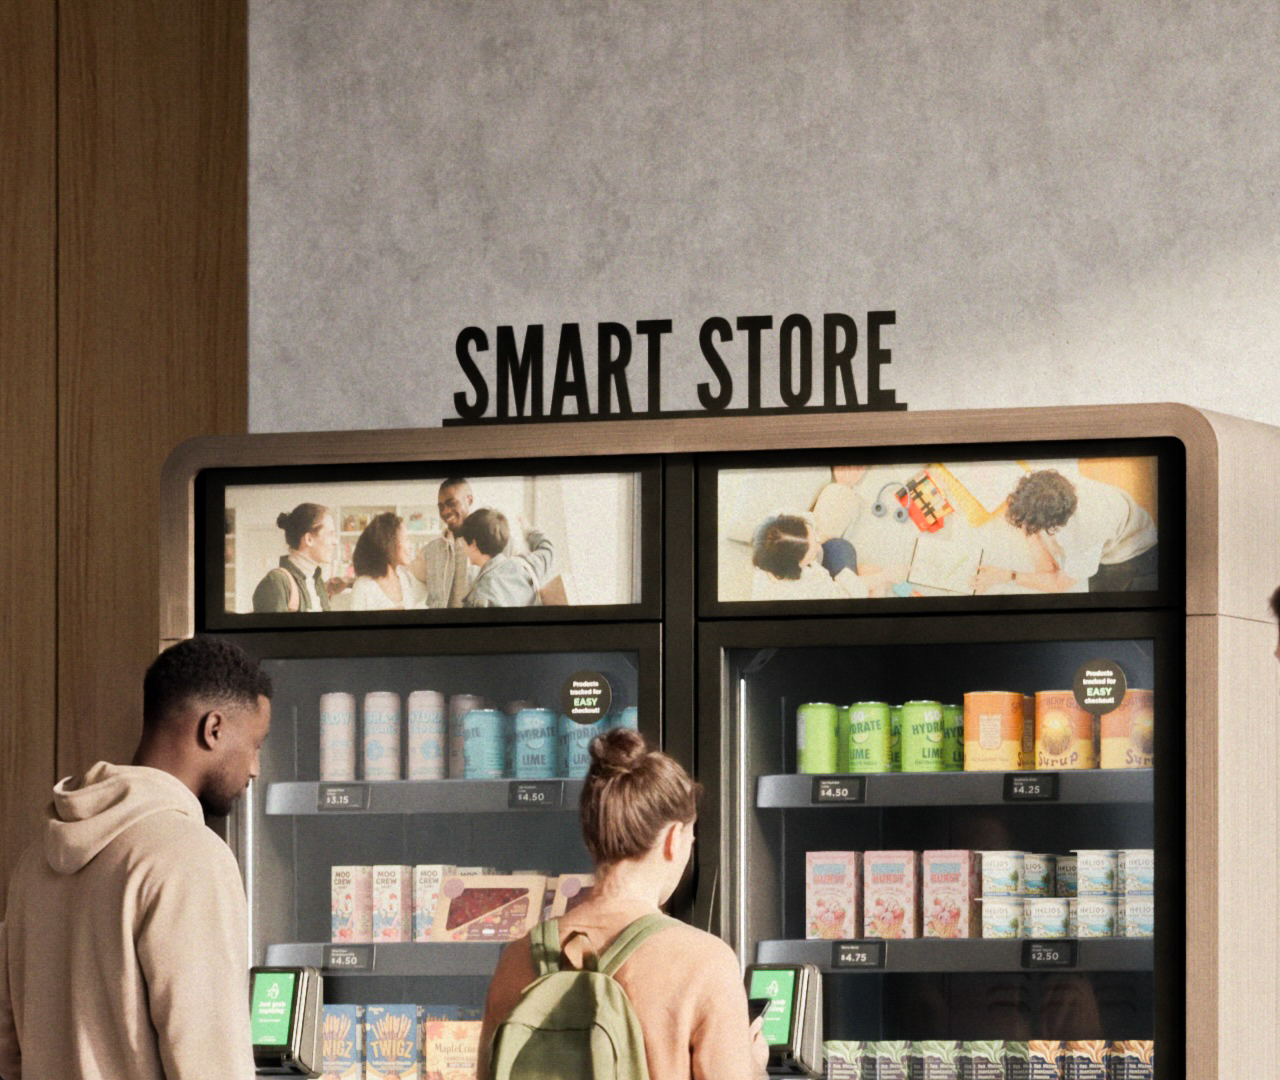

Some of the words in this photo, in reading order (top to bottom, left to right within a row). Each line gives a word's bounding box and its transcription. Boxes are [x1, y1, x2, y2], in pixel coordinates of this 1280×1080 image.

[454, 317, 673, 419] SMART
[696, 309, 898, 412] STORE
[1086, 687, 1113, 696] EASY
[573, 697, 598, 707] EASY
[523, 754, 546, 765] LIME
[1038, 752, 1078, 766] Syrup
[821, 788, 849, 797] $4.50
[1013, 786, 1040, 794] $4.25
[326, 795, 349, 804] $3.15
[517, 793, 545, 801] $4.50
[377, 870, 396, 878] MOO
[871, 874, 904, 883] BURST
[929, 873, 960, 883] BURST
[418, 877, 439, 885] CREW
[330, 957, 357, 965] $4.50
[840, 953, 867, 962] $4.75
[1032, 952, 1059, 961] $2.50
[370, 1039, 414, 1058] TWIGZ
